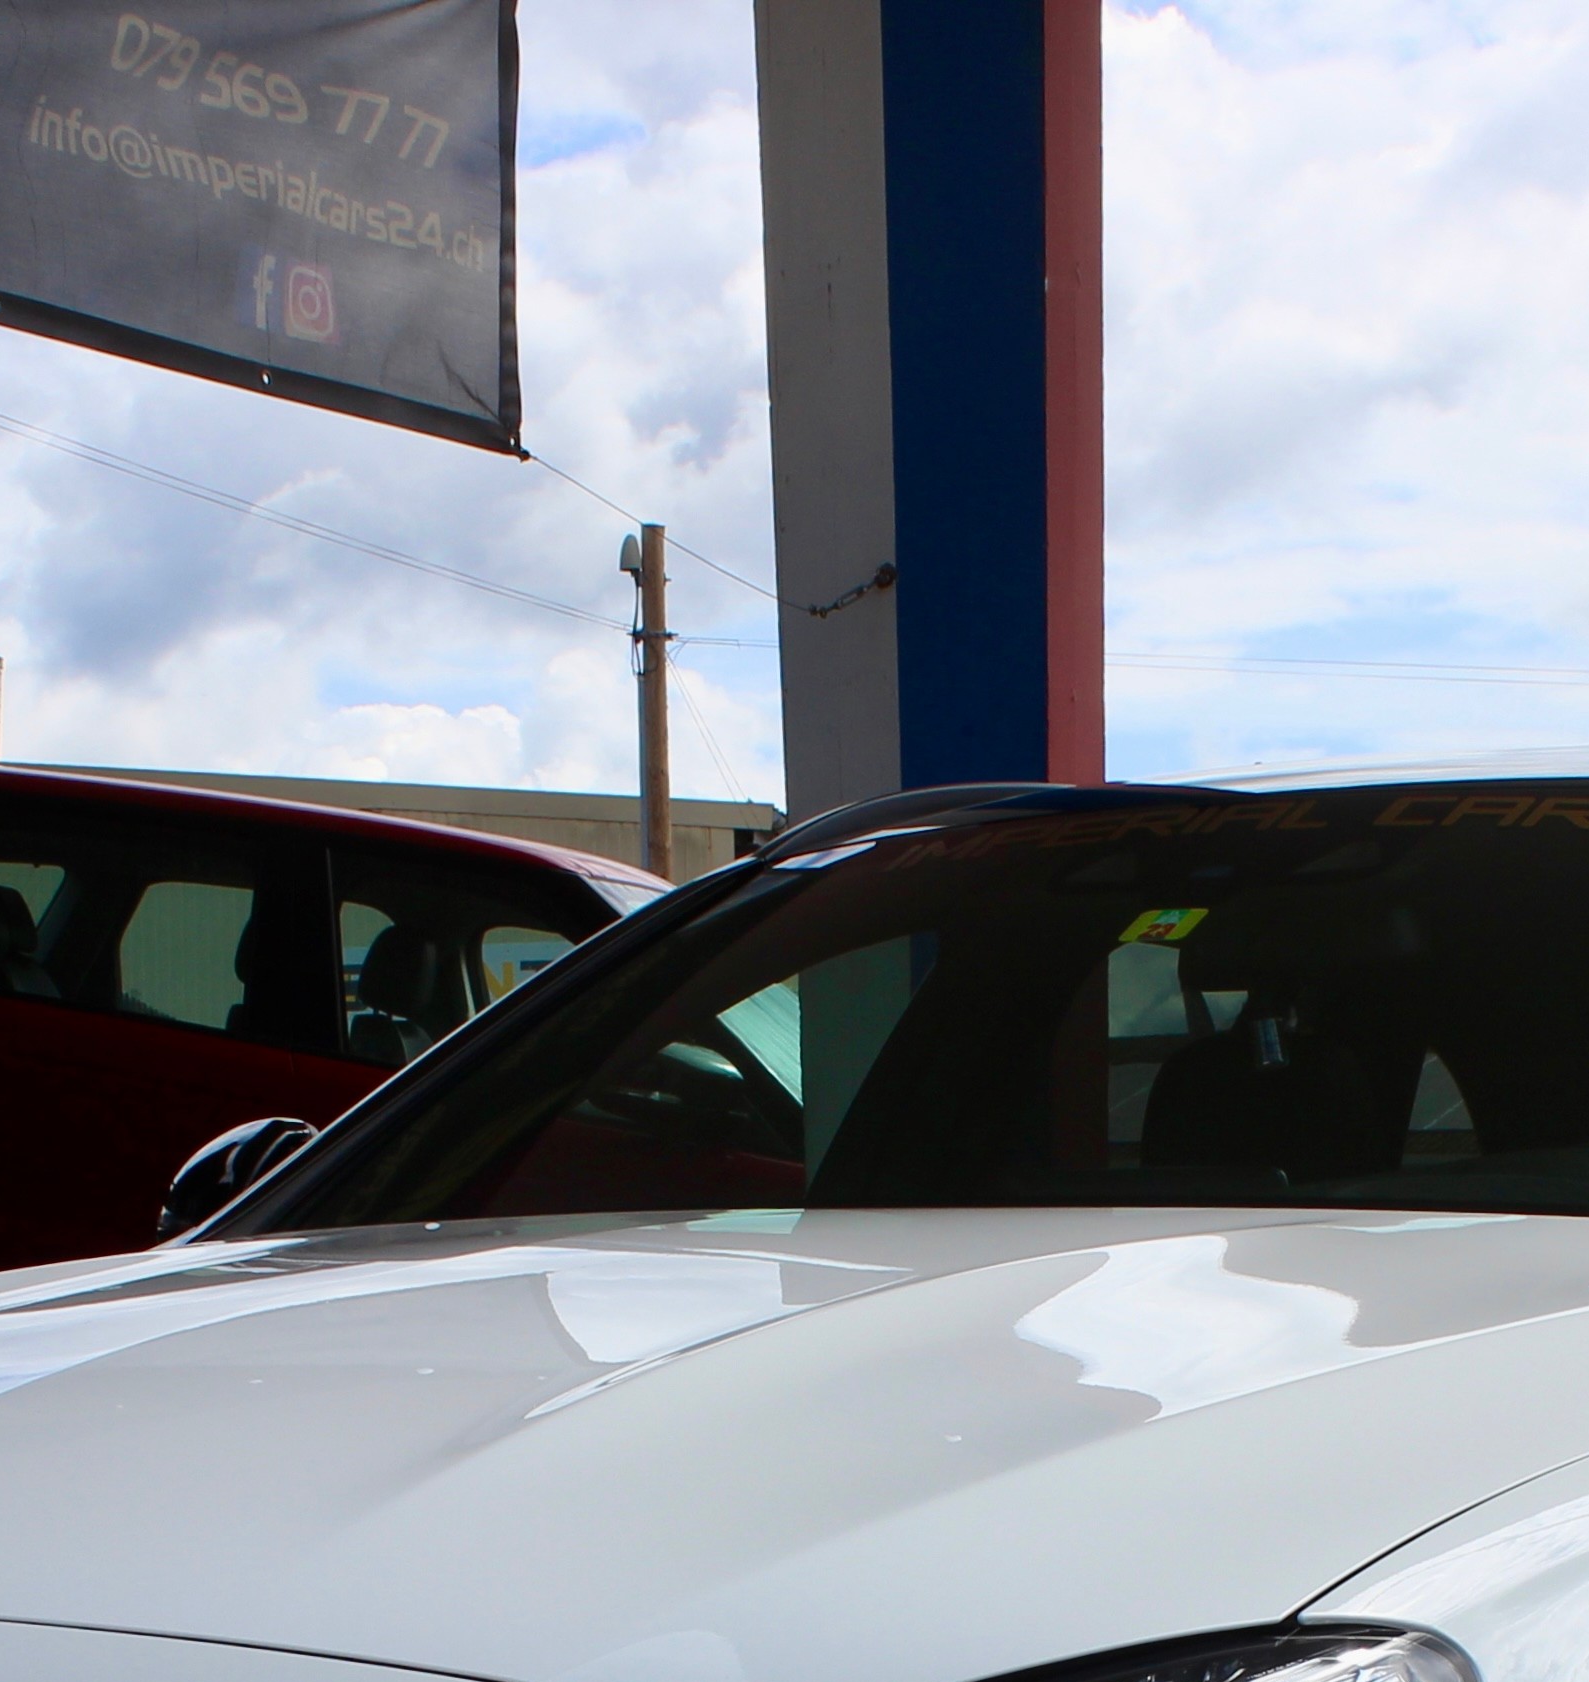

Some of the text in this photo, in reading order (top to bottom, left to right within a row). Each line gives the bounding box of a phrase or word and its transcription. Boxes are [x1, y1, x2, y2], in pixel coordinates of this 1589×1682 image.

[112, 13, 450, 168] 079 569 77 77
[29, 96, 484, 273] info@imperialcars24.ch
[882, 799, 1326, 872] IMPERIAL
